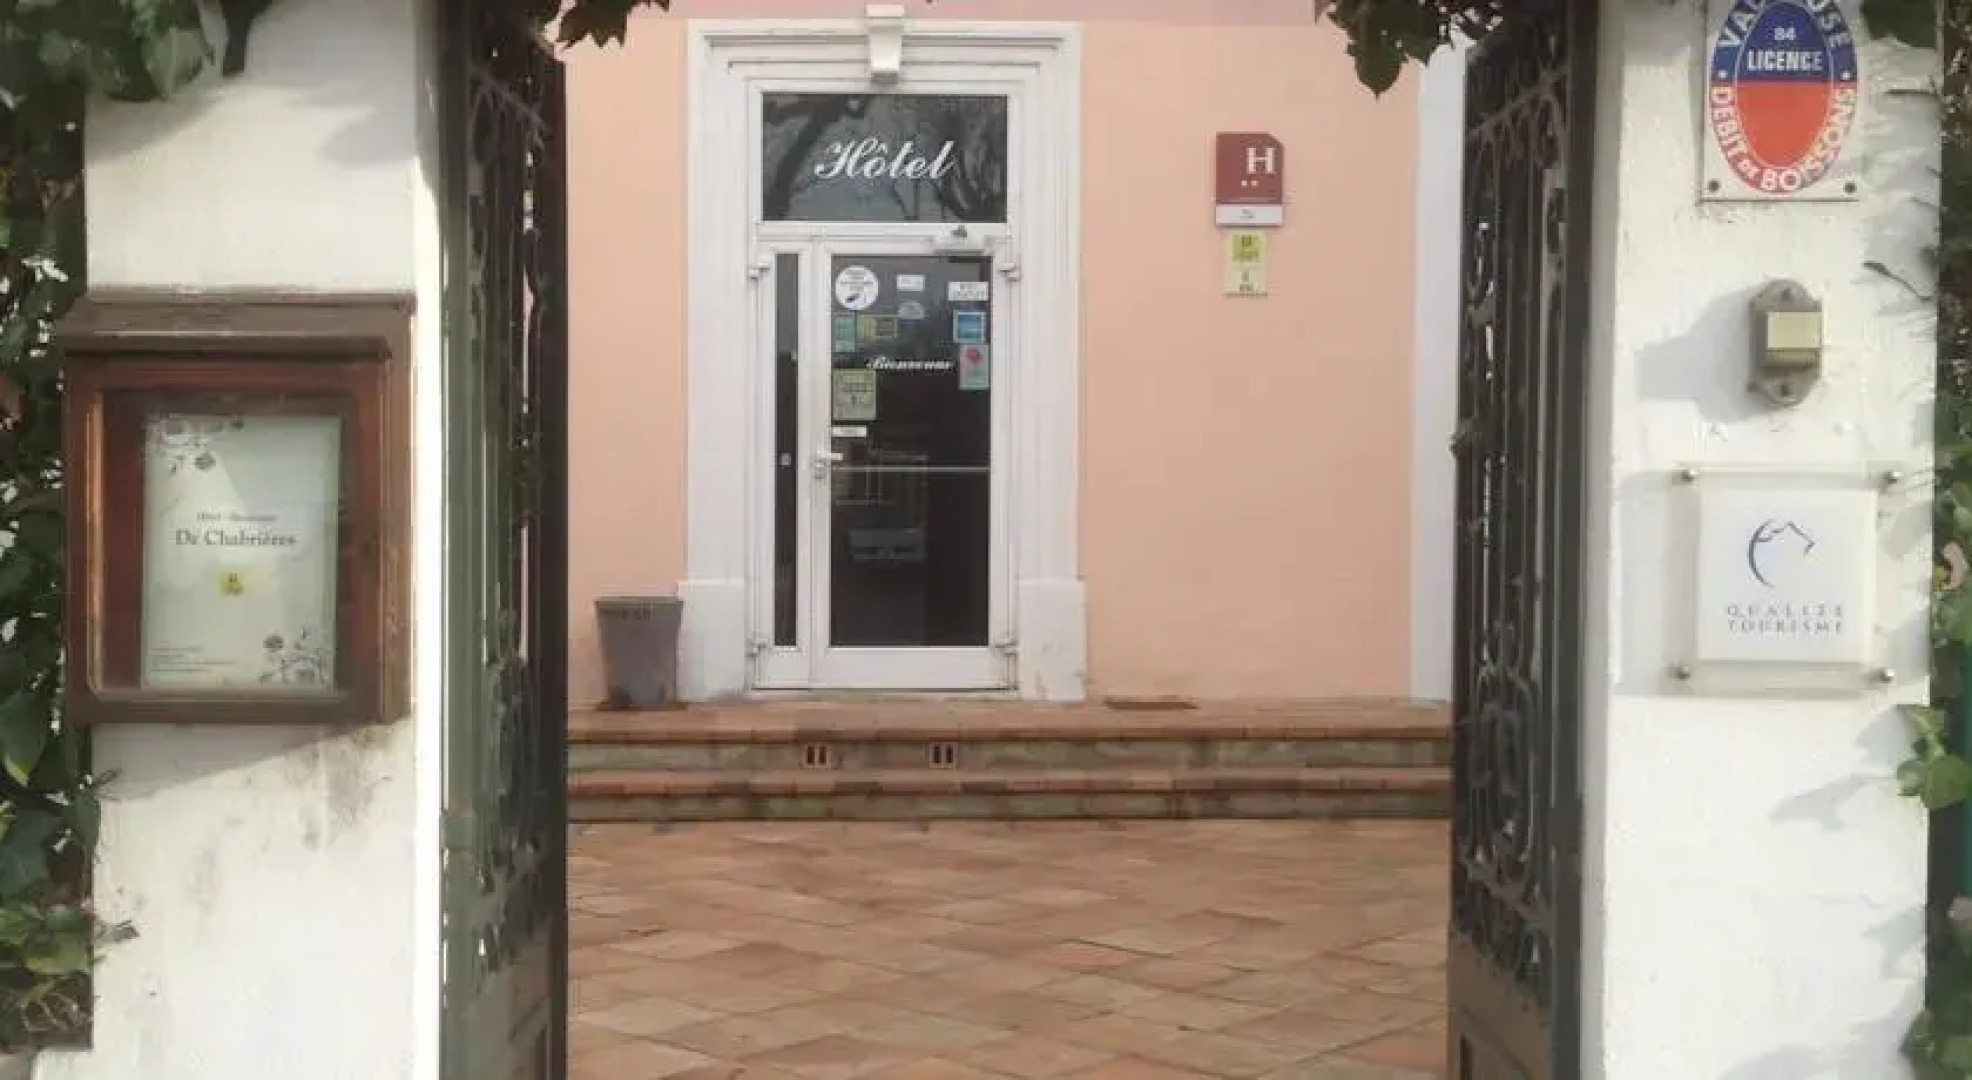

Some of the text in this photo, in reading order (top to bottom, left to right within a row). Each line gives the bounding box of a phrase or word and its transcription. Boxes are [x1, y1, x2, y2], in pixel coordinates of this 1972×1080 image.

[1774, 27, 1796, 41] 84
[1747, 51, 1823, 71] LICENCE
[1761, 87, 1858, 191] BOISSONS
[814, 137, 957, 180] Hôtel
[1246, 147, 1276, 175] H
